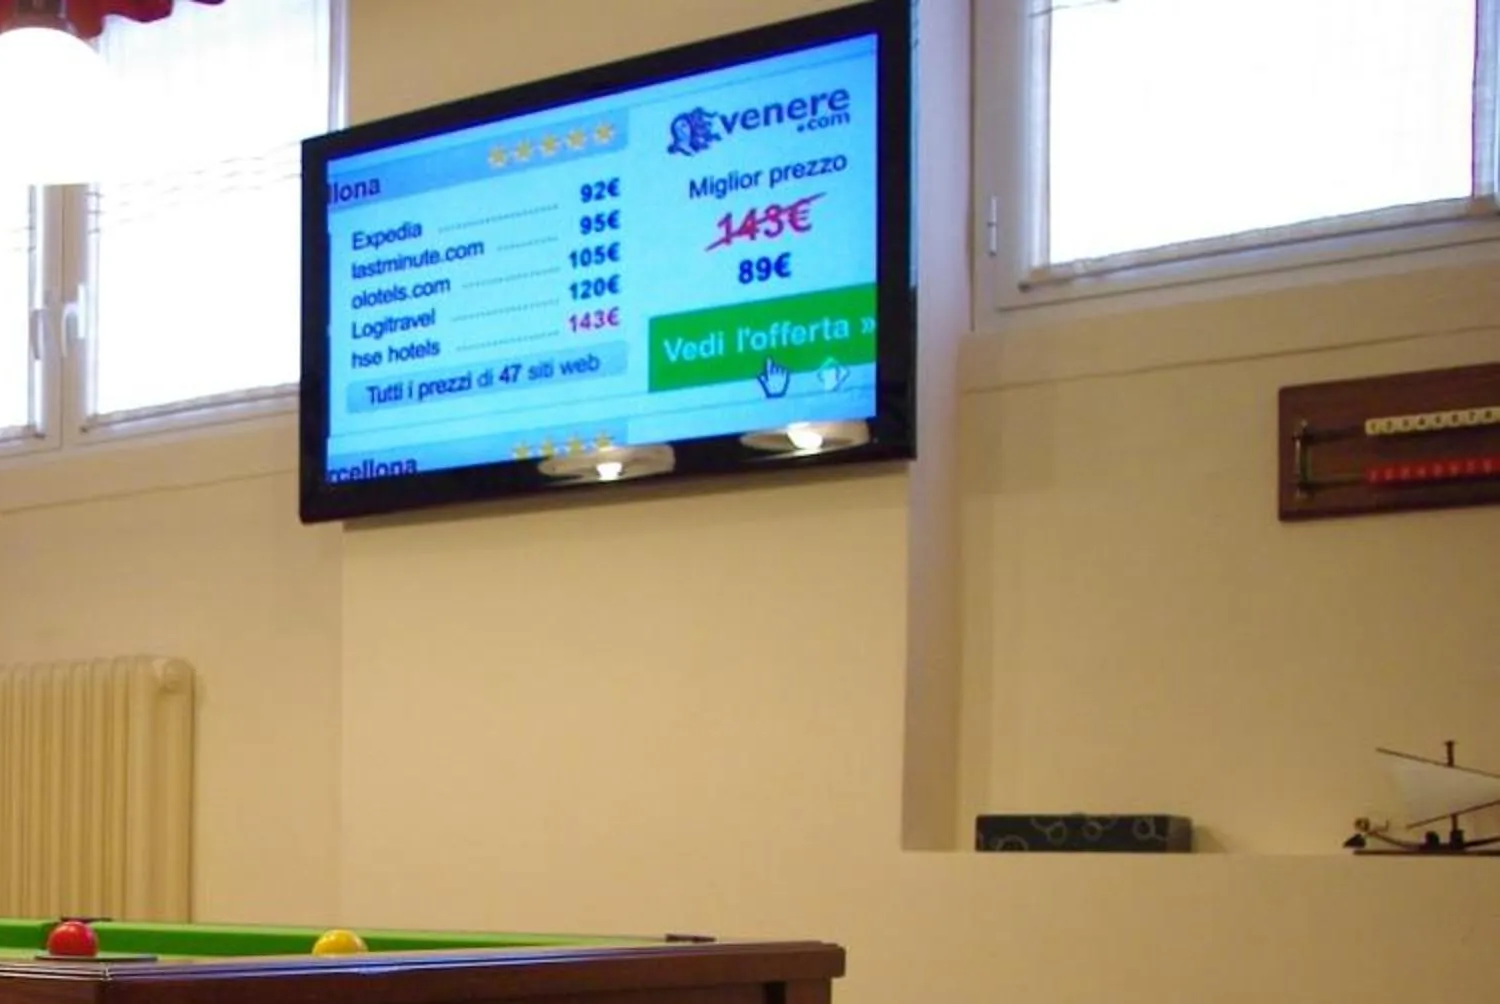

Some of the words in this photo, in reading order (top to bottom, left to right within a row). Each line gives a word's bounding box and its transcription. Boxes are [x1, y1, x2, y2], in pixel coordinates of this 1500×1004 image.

[719, 88, 850, 134] venere
[689, 170, 763, 200] Miglior
[769, 154, 848, 189] prezzo
[352, 221, 422, 250] Expedia
[580, 177, 620, 203] 92€
[352, 241, 485, 280] lastminute.com
[580, 209, 620, 235] 95€
[569, 241, 620, 269] 105€
[738, 252, 791, 284] 89€
[352, 307, 436, 340] Logitravel
[569, 273, 620, 300] 120€
[352, 350, 382, 369] hse
[388, 338, 441, 363] hotels
[569, 305, 620, 333] 143€
[663, 330, 725, 363] Vedi
[736, 316, 850, 354] l'offerta
[365, 382, 403, 405] Tutti
[418, 371, 472, 403] prezzi
[477, 367, 494, 388] di
[498, 363, 522, 385] 47
[527, 357, 554, 380] siti
[560, 353, 600, 376] web
